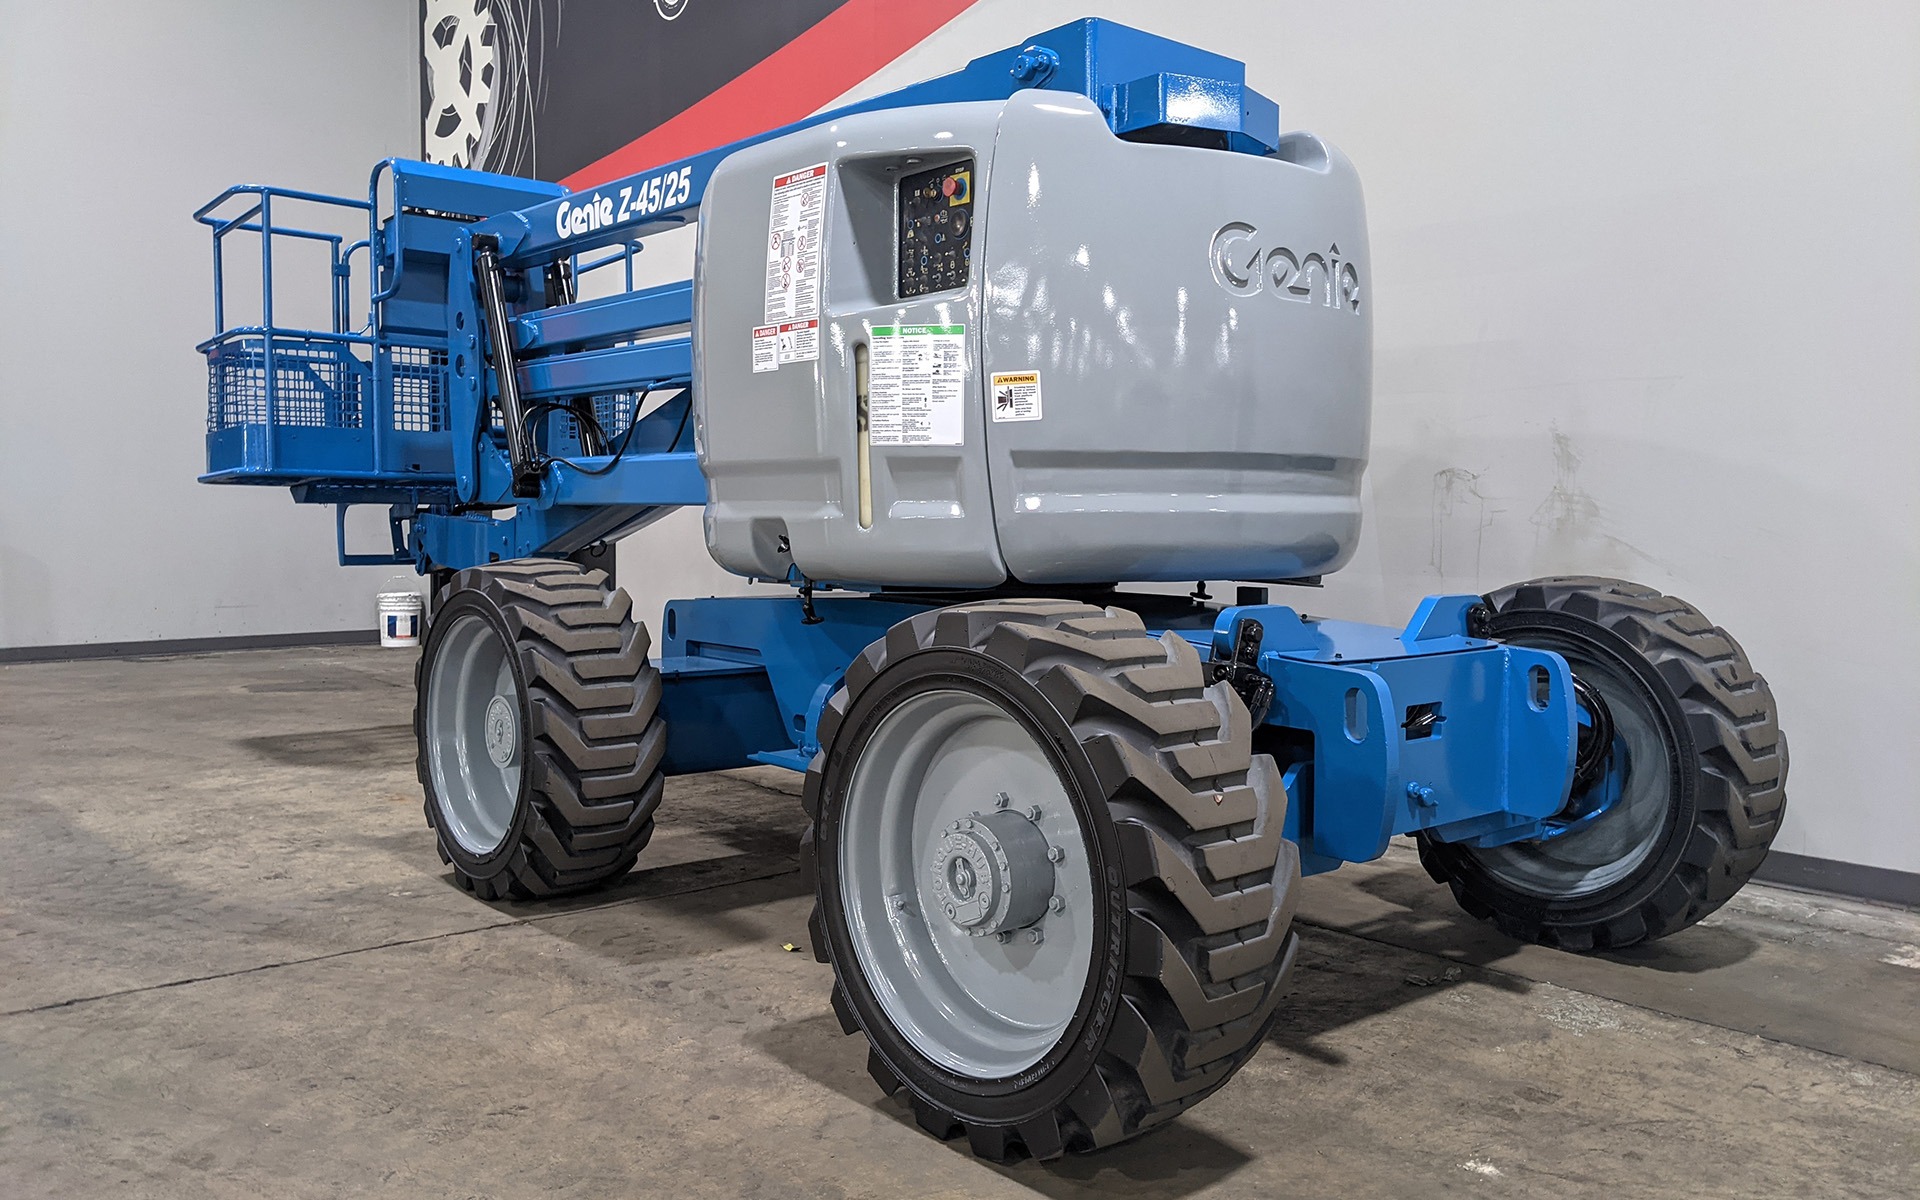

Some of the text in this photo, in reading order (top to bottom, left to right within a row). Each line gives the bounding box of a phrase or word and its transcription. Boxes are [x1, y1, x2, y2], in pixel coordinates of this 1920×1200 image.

[791, 170, 815, 182] DANGER
[617, 166, 692, 223] Z-45/25
[759, 327, 776, 336] DANGER
[791, 321, 809, 330] DANGER
[1083, 866, 1122, 1051] OUTRIGGER
